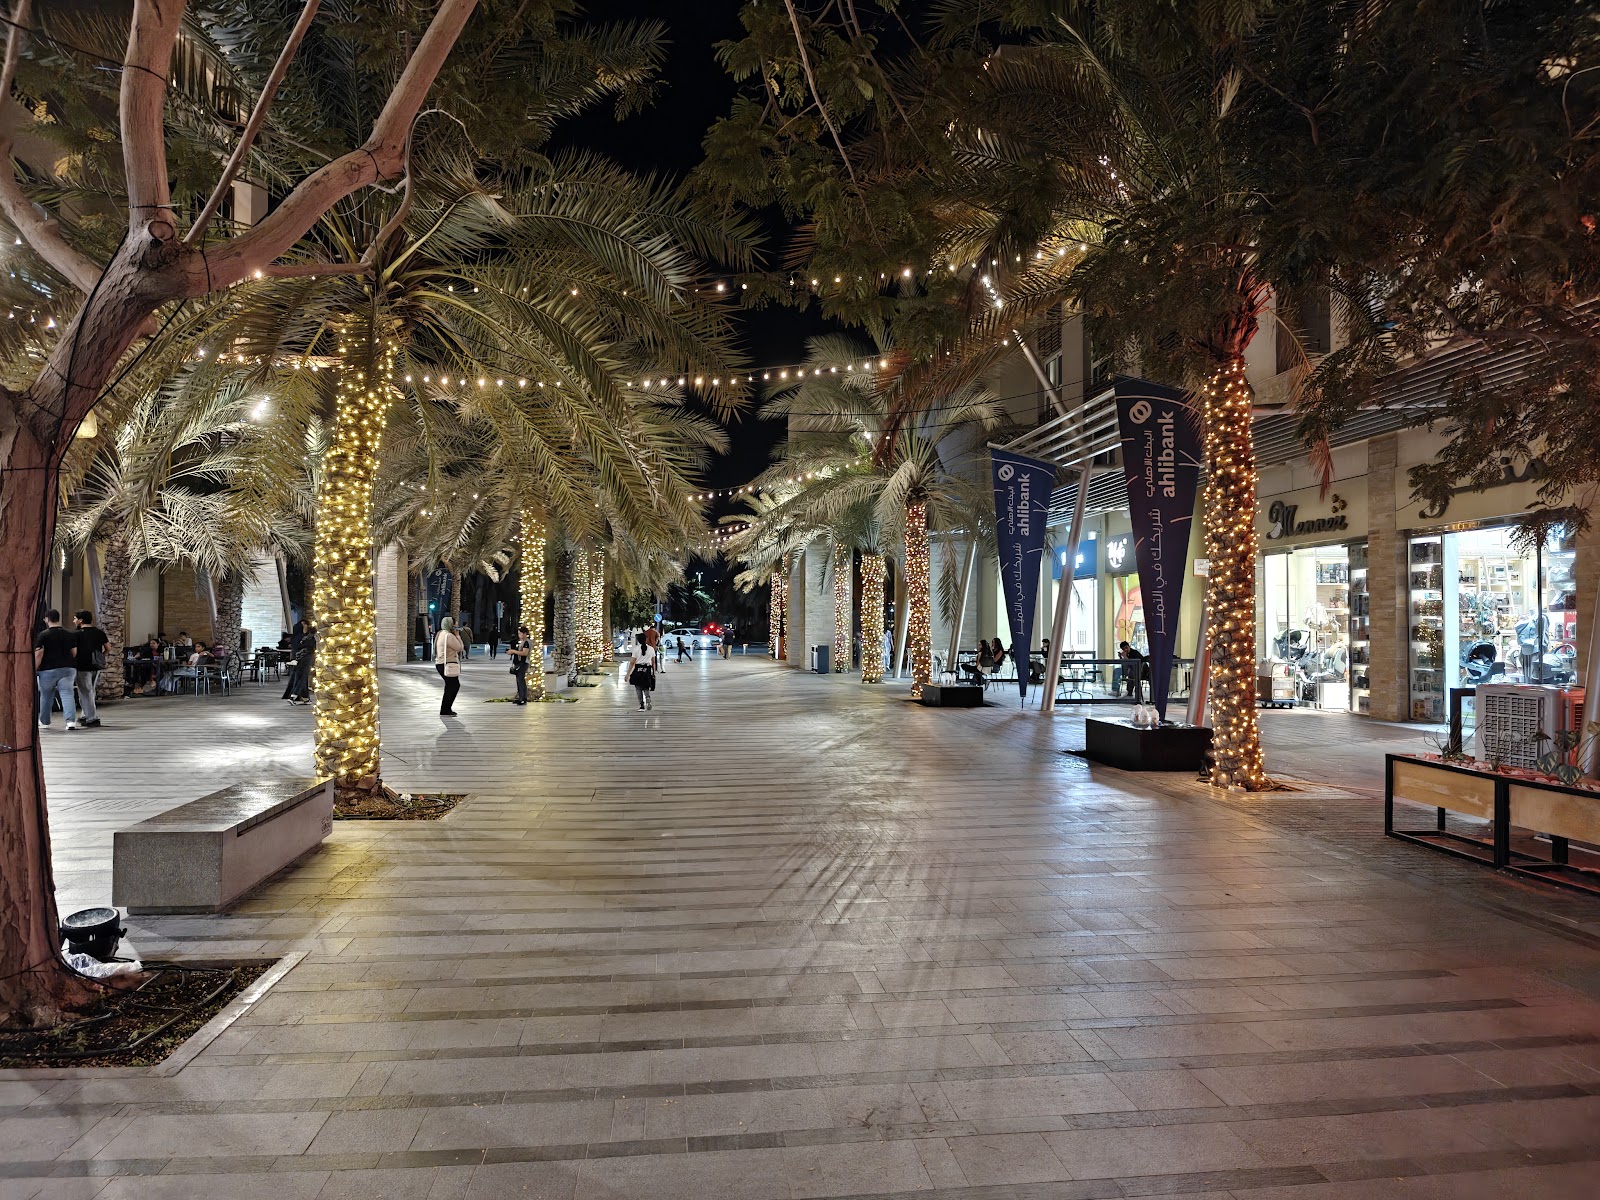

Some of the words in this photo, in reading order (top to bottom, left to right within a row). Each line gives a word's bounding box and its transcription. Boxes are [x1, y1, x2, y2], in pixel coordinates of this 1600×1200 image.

[1157, 411, 1175, 497] ahlibank
[1017, 473, 1030, 536] ahlibank
[1014, 582, 1025, 600] في
[1152, 562, 1168, 588] في
